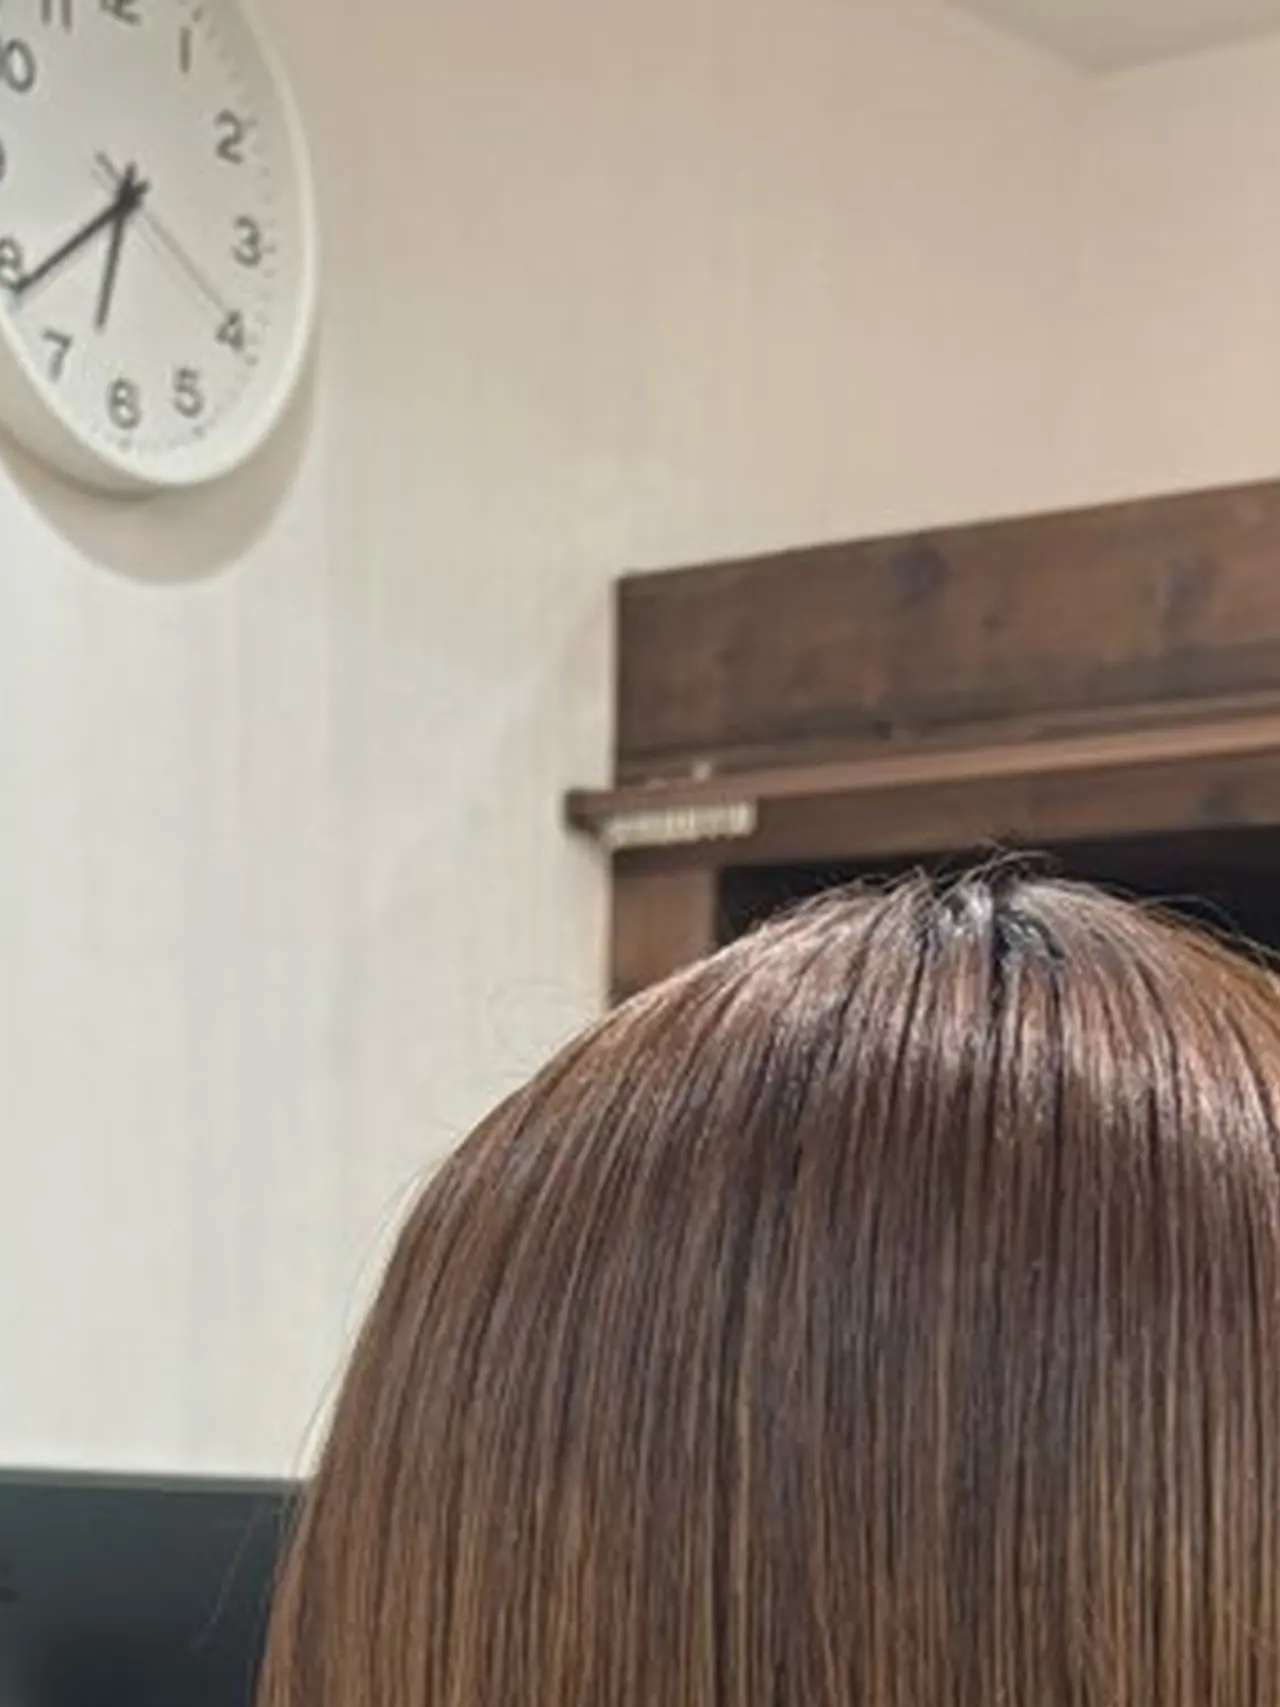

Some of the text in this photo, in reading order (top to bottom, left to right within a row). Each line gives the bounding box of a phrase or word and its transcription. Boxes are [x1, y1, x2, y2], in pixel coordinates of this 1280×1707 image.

[179, 27, 192, 74] 1
[214, 109, 245, 164] 2
[231, 215, 263, 267] 3
[41, 330, 72, 381] 7
[215, 308, 246, 353] 4
[107, 377, 141, 429] 6
[173, 368, 205, 417] 5
